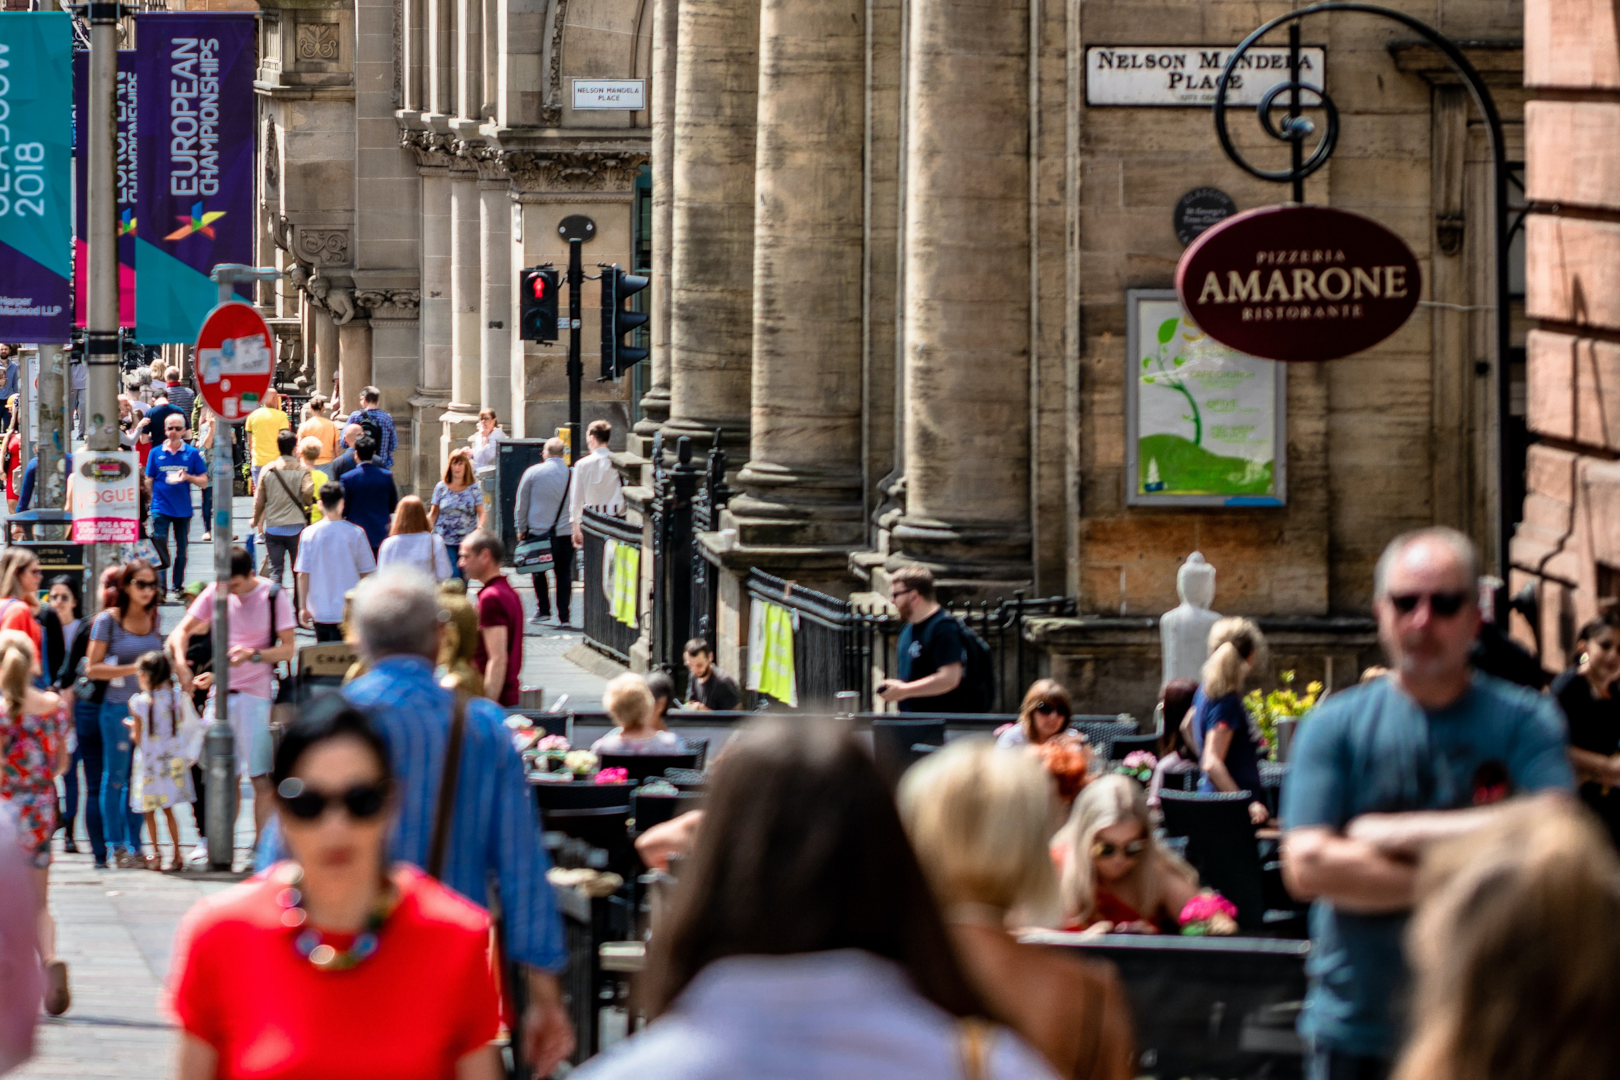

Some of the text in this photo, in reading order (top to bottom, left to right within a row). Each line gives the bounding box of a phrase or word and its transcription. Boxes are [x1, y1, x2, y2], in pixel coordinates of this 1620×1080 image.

[1098, 51, 1187, 70] NELSON
[171, 38, 198, 196] EUROPEAN
[200, 38, 218, 196] CHAMPIONSHIPS
[14, 142, 45, 217] 2018
[1256, 250, 1346, 265] PIZZERIA
[1198, 266, 1408, 304] AMARONE
[42, 305, 62, 316] LLP
[1242, 304, 1364, 321] RISTORANTE
[76, 488, 136, 512] VOGUE
